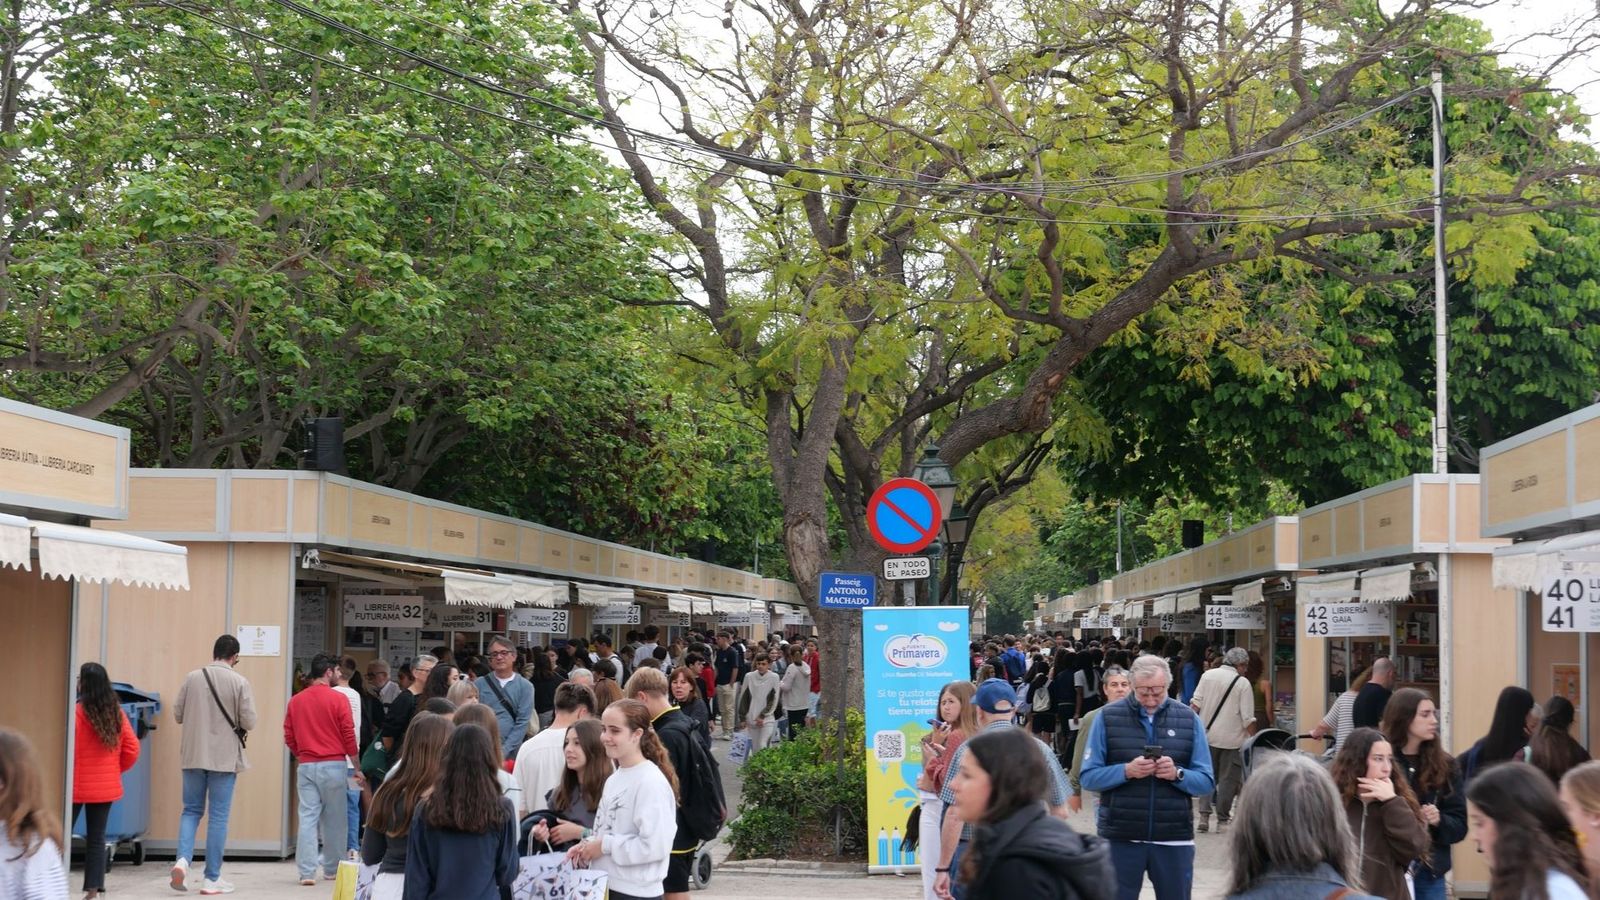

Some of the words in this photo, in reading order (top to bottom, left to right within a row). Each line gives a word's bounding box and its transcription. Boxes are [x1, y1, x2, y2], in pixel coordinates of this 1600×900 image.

[903, 560, 926, 568] TODO
[887, 570, 896, 578] EL
[900, 569, 928, 577] PASEO
[834, 577, 861, 587] Passeig
[828, 586, 868, 596] ANTONIO
[1547, 578, 1584, 602] 40
[825, 596, 870, 605] MACHADO
[402, 605, 422, 618] 32
[627, 606, 639, 614] 27
[1207, 606, 1222, 616] 44
[1307, 606, 1328, 619] 42
[354, 612, 401, 620] FUTURAMA
[476, 611, 491, 623] 31
[552, 611, 566, 621] 29
[627, 615, 639, 624] 28
[1161, 614, 1174, 622] 46
[1547, 606, 1574, 628] 41
[551, 622, 566, 632] 30
[1138, 619, 1148, 627] 49
[1161, 622, 1173, 631] 47
[1207, 617, 1223, 628] 45
[1307, 621, 1329, 635] 43
[892, 647, 940, 658] Primavera
[877, 689, 886, 698] Si
[887, 689, 897, 697] te
[899, 698, 909, 706] tu
[888, 707, 913, 715] tiene
[549, 885, 566, 897] 61
